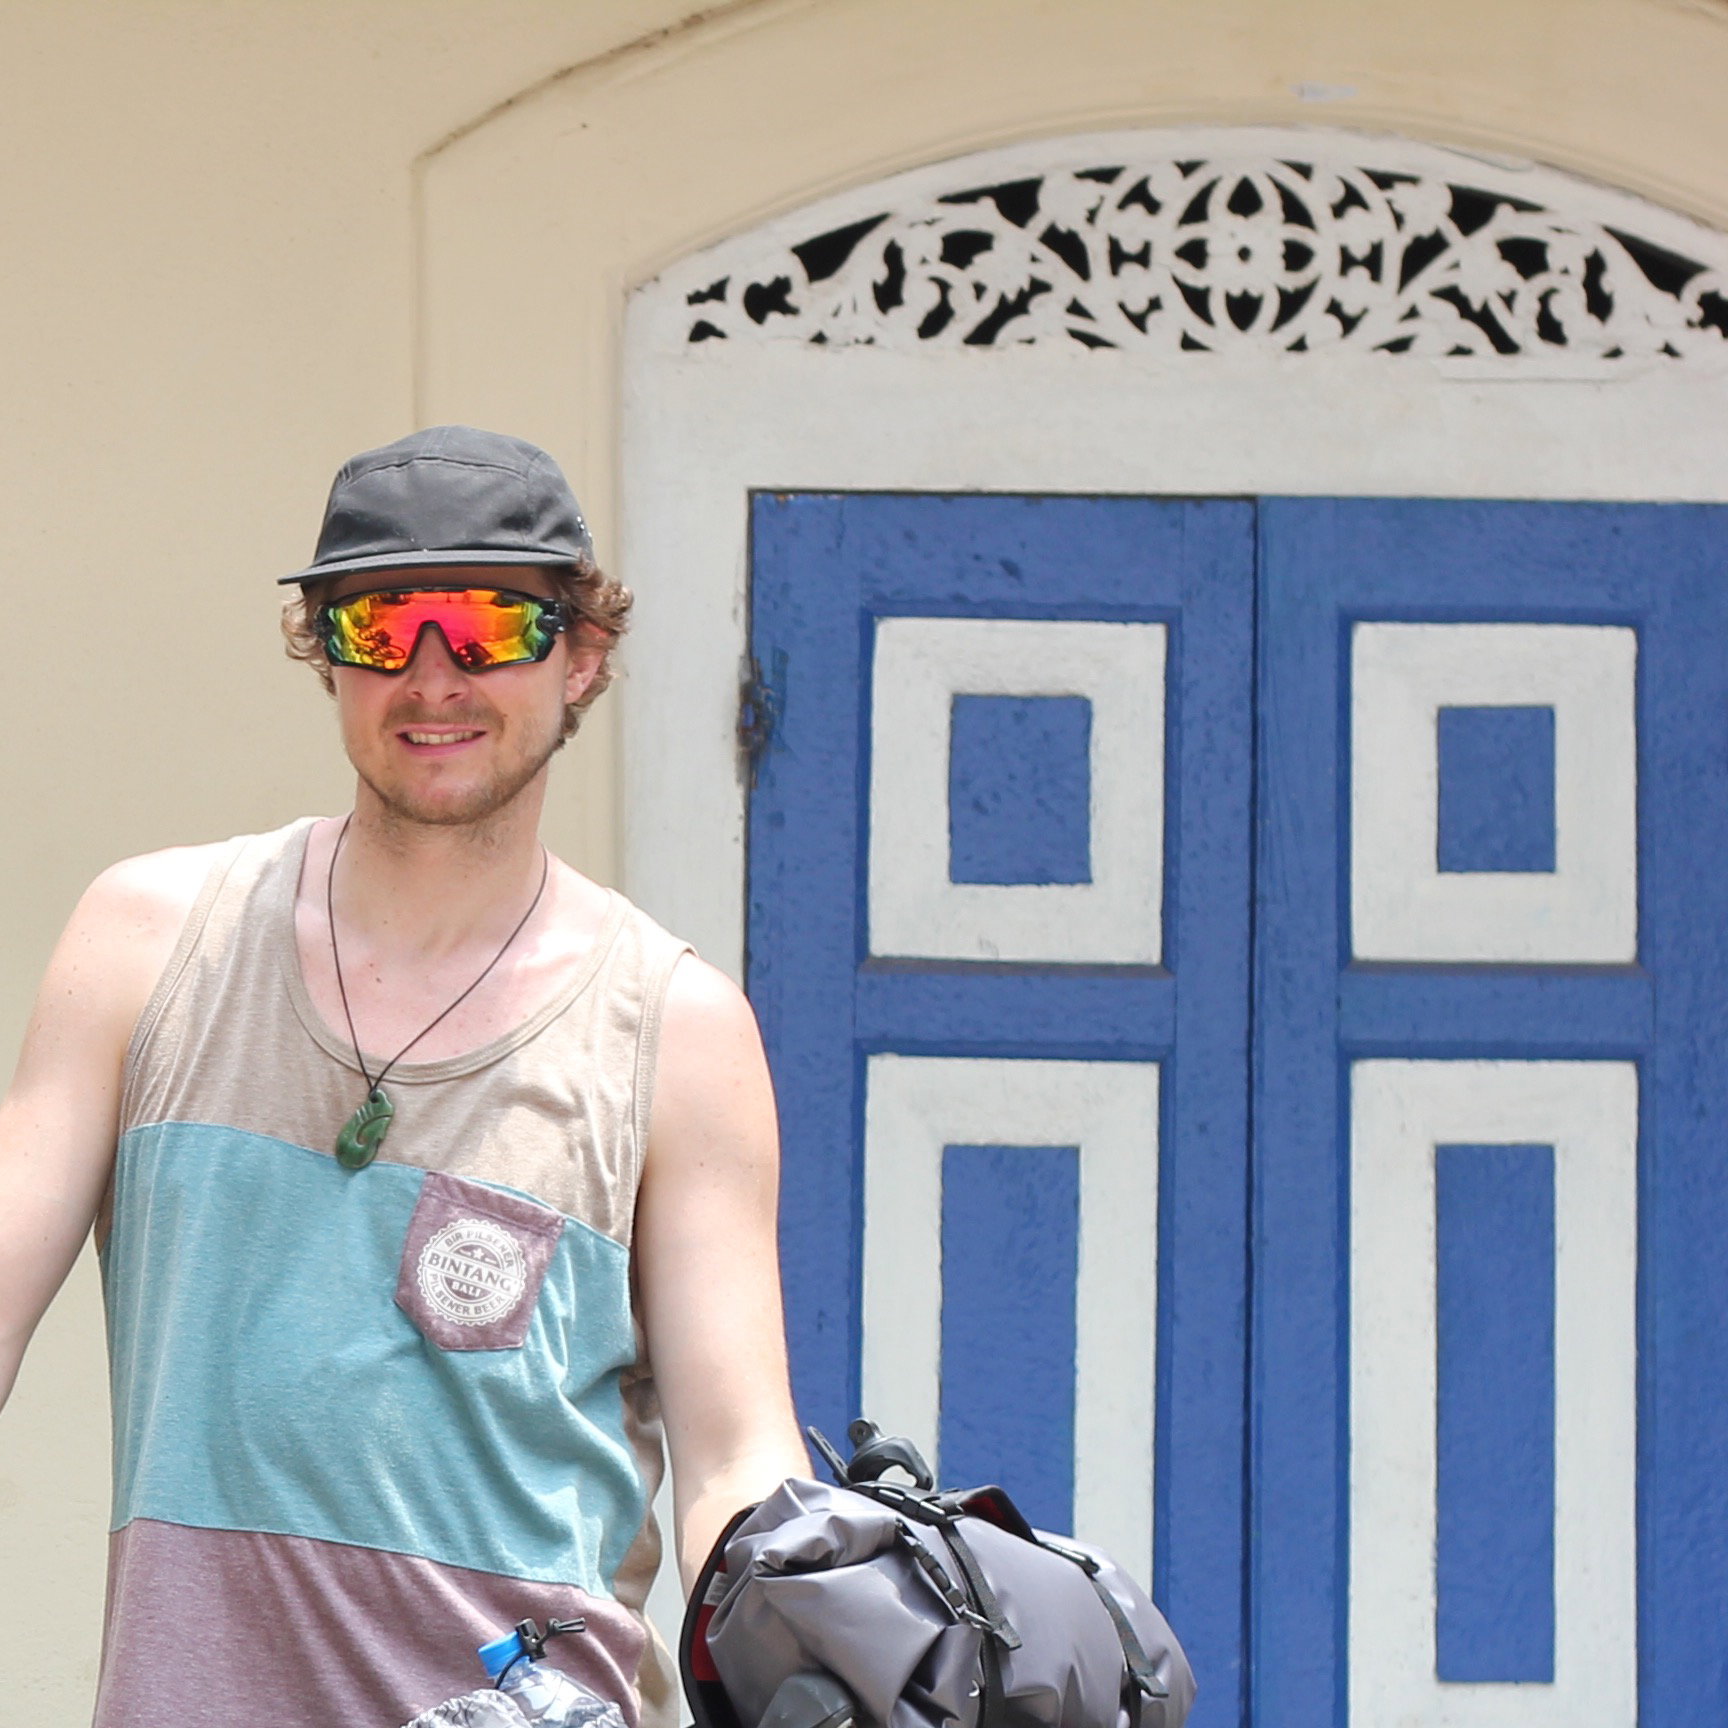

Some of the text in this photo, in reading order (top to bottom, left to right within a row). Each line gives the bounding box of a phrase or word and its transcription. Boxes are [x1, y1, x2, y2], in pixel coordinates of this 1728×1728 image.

[428, 1253, 513, 1292] BINTANG
[451, 1280, 482, 1298] BALI
[474, 1296, 504, 1316] BEER
